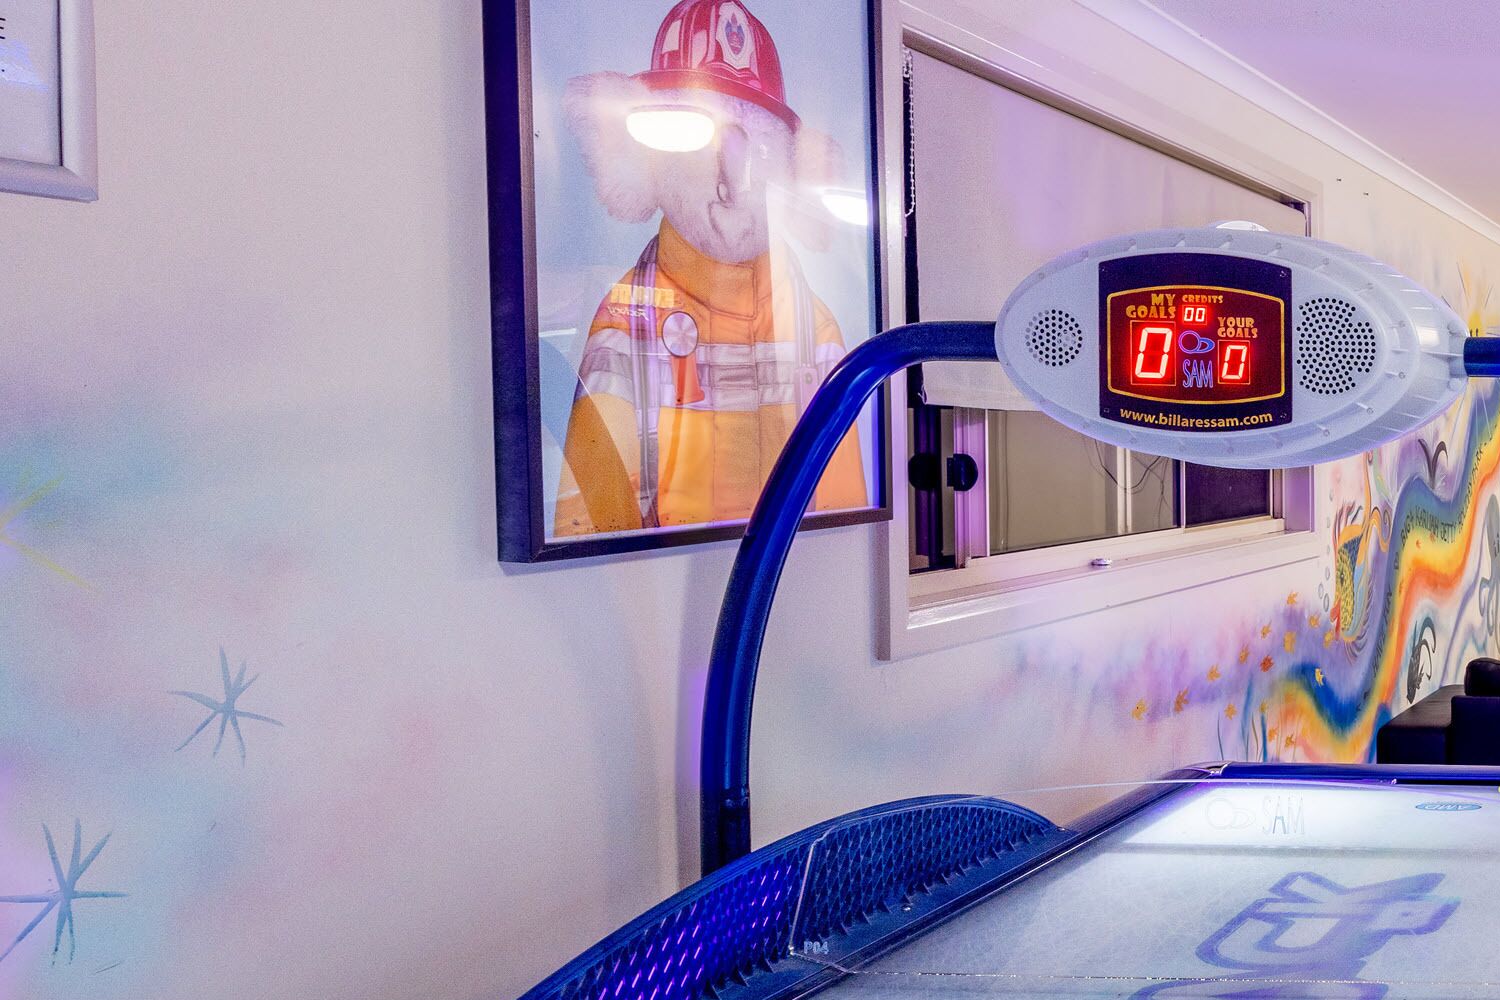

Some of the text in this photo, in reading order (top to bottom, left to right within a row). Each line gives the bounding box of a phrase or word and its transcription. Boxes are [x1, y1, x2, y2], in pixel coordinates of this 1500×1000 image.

[1151, 293, 1176, 306] MY
[1182, 295, 1224, 304] CREDITS
[1125, 305, 1177, 319] GOALS
[1183, 307, 1206, 322] 00
[1217, 317, 1255, 328] YOUR
[1217, 327, 1258, 339] GOALS
[1135, 327, 1173, 379] 0
[1221, 345, 1248, 380] 0
[1182, 358, 1214, 389] SAM
[1119, 408, 1273, 428] www.billaressam.com
